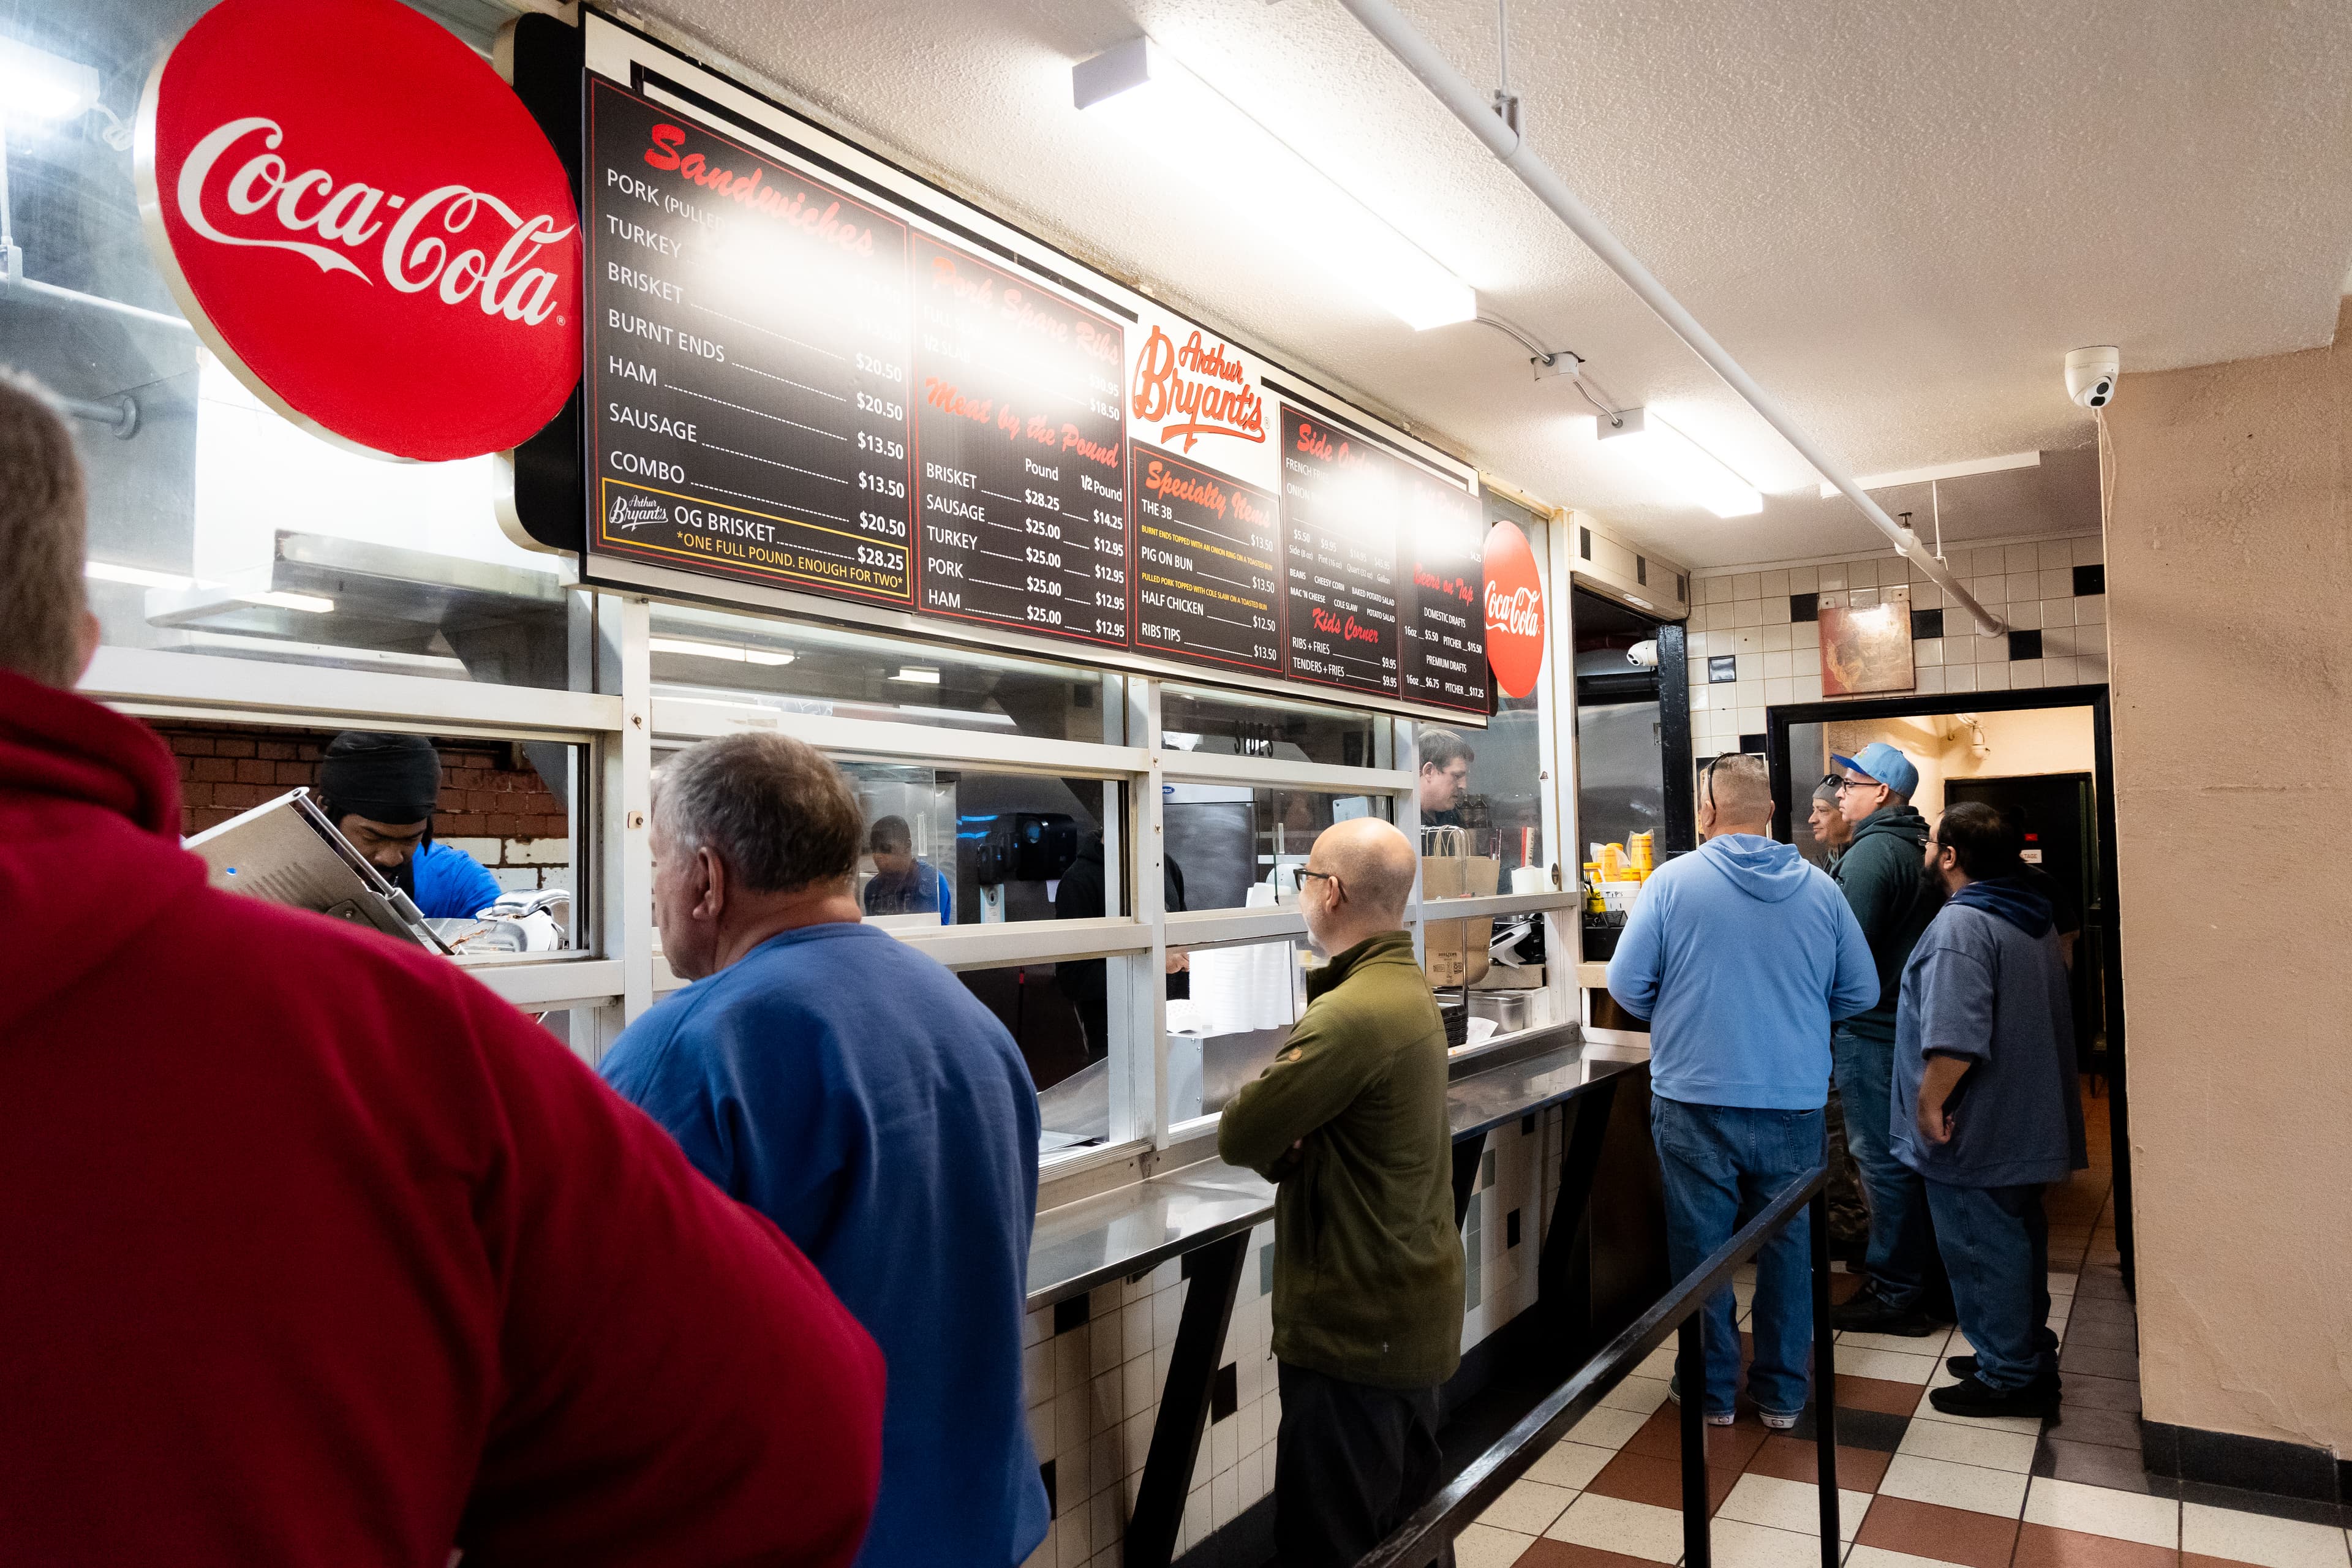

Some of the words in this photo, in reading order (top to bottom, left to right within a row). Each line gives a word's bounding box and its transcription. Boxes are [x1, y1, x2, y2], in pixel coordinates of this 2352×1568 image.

[608, 168, 660, 206] PORK
[665, 195, 725, 231] (PULLED
[644, 124, 874, 257] Sandwiches
[178, 117, 576, 326] Coca-Cola
[607, 214, 681, 257] TURKEY
[609, 262, 684, 303] BRISKET
[856, 352, 902, 382] $20.50
[1000, 288, 1068, 342] Spare
[1076, 322, 1120, 366] Ribs
[609, 309, 673, 345] BURNT
[679, 332, 724, 362] ENDS
[857, 391, 902, 420] $20.50
[1178, 330, 1243, 385] Arthur
[610, 356, 656, 386] HAM
[858, 431, 903, 459] $13.50
[1132, 325, 1265, 454] Bryant's
[925, 377, 992, 424] Meat
[998, 404, 1020, 440] by
[1027, 414, 1055, 446] the
[1061, 423, 1118, 468] Pound
[1090, 398, 1120, 421] $18.50
[610, 403, 696, 442] SAUSAGE
[859, 470, 904, 498] $13.50
[1297, 424, 1332, 461] Side
[1026, 458, 1058, 481] Pound
[1286, 458, 1312, 477] FRENCH
[611, 451, 684, 483] COMBO
[860, 511, 905, 537] $20.50
[628, 494, 657, 508] Arthur
[927, 462, 976, 489] BRISKET
[1025, 488, 1059, 510] $28.25
[1094, 509, 1123, 530] $14.25
[1081, 475, 1092, 491] 1/2
[1094, 480, 1122, 502] Pound
[1145, 461, 1226, 520] Specialty
[1287, 483, 1310, 500] ONION
[609, 497, 669, 532] Bryant's
[927, 494, 985, 522] SAUSAGE
[1026, 518, 1060, 539] $25.00
[1095, 537, 1123, 556] $12.95
[1142, 499, 1159, 516] THE
[1161, 505, 1172, 519] 3B
[1251, 534, 1273, 551] $13.50
[675, 507, 701, 527] OG
[709, 513, 775, 542] BRISKET
[858, 545, 903, 570] $28.25
[927, 526, 977, 549] TURKEY
[1027, 546, 1060, 568] $25.00
[1095, 564, 1123, 583] $12.95
[1142, 525, 1158, 536] BURNT
[1159, 530, 1172, 540] ENDS
[1172, 534, 1190, 545] TOPPED
[1191, 540, 1203, 550] WITH
[1212, 546, 1225, 556] ONION
[1226, 551, 1235, 559] RING
[1247, 557, 1264, 569] TOASTED
[1289, 545, 1300, 556] Side
[1294, 529, 1310, 543] $5.50
[1321, 538, 1337, 552] $9.95
[717, 540, 745, 557] FULL
[750, 546, 794, 567] POUND.
[799, 557, 846, 578] ENOUGH
[851, 568, 870, 582] FOR
[1142, 546, 1156, 561] PIG
[1159, 551, 1172, 565] ON
[1175, 555, 1192, 571] BUN
[1253, 576, 1274, 593] $13.50
[1290, 568, 1306, 579] BEANS
[1319, 554, 1328, 564] Pint
[1348, 564, 1360, 574] Quart
[929, 557, 963, 578] PORK
[1027, 576, 1061, 596] $25.00
[1096, 591, 1124, 610] $12.95
[1142, 573, 1160, 582] PULLED
[1161, 578, 1174, 586] PORK
[1175, 581, 1193, 591] TOPPED
[1193, 586, 1205, 594] WITH
[1206, 589, 1217, 597] COLE
[1218, 592, 1229, 600] SLAW
[1241, 598, 1258, 608] TOASTED
[1291, 587, 1302, 597] MAC
[1309, 592, 1325, 603] CHEESE
[1314, 576, 1332, 587] CHEESY
[1332, 581, 1344, 591] CORN
[1352, 587, 1367, 598] BAKED
[1366, 592, 1381, 602] POTATO
[1382, 597, 1395, 606] SALAD
[1378, 573, 1390, 584] Gallon
[1456, 578, 1474, 607] Tap
[929, 589, 960, 608] HAM
[1027, 605, 1061, 624] $25.00
[1096, 619, 1124, 637] $12.95
[1142, 590, 1164, 606] HALF
[1167, 597, 1203, 616] CHICKEN
[1253, 615, 1275, 631] $12.50
[1334, 599, 1346, 608] COLE
[1346, 602, 1357, 612] SLAW
[1367, 608, 1382, 619] POTATO
[1382, 613, 1395, 622] SALAD
[1425, 607, 1448, 622] DOMESTIC
[1449, 615, 1465, 628] DRAFTS
[1485, 580, 1540, 637] Coca-Cola
[1142, 623, 1161, 638] RIBS
[1163, 627, 1180, 642] TIPS
[1254, 644, 1276, 660] $13.50
[1313, 608, 1341, 634] Kids
[1344, 616, 1378, 643] Corner
[1404, 625, 1417, 637] 16oz
[1425, 630, 1438, 642] $5.50
[1444, 636, 1461, 649] PITCHER
[1468, 641, 1482, 654] $15.50
[1293, 637, 1306, 649] RIBS
[1314, 641, 1330, 654] FRIES
[1382, 657, 1396, 669] $9.95
[1427, 655, 1449, 668] PREMIUM
[1450, 661, 1466, 673] DRAFTS
[1293, 657, 1322, 673] TENDERS
[1329, 665, 1344, 676] FRIES
[1383, 675, 1396, 687] $9.95
[1406, 674, 1419, 685] 16oz
[1426, 677, 1439, 688] $6.75
[1446, 682, 1463, 695] PITCHER
[1470, 686, 1483, 698] $17.25
[1234, 720, 1273, 758] SIDES
